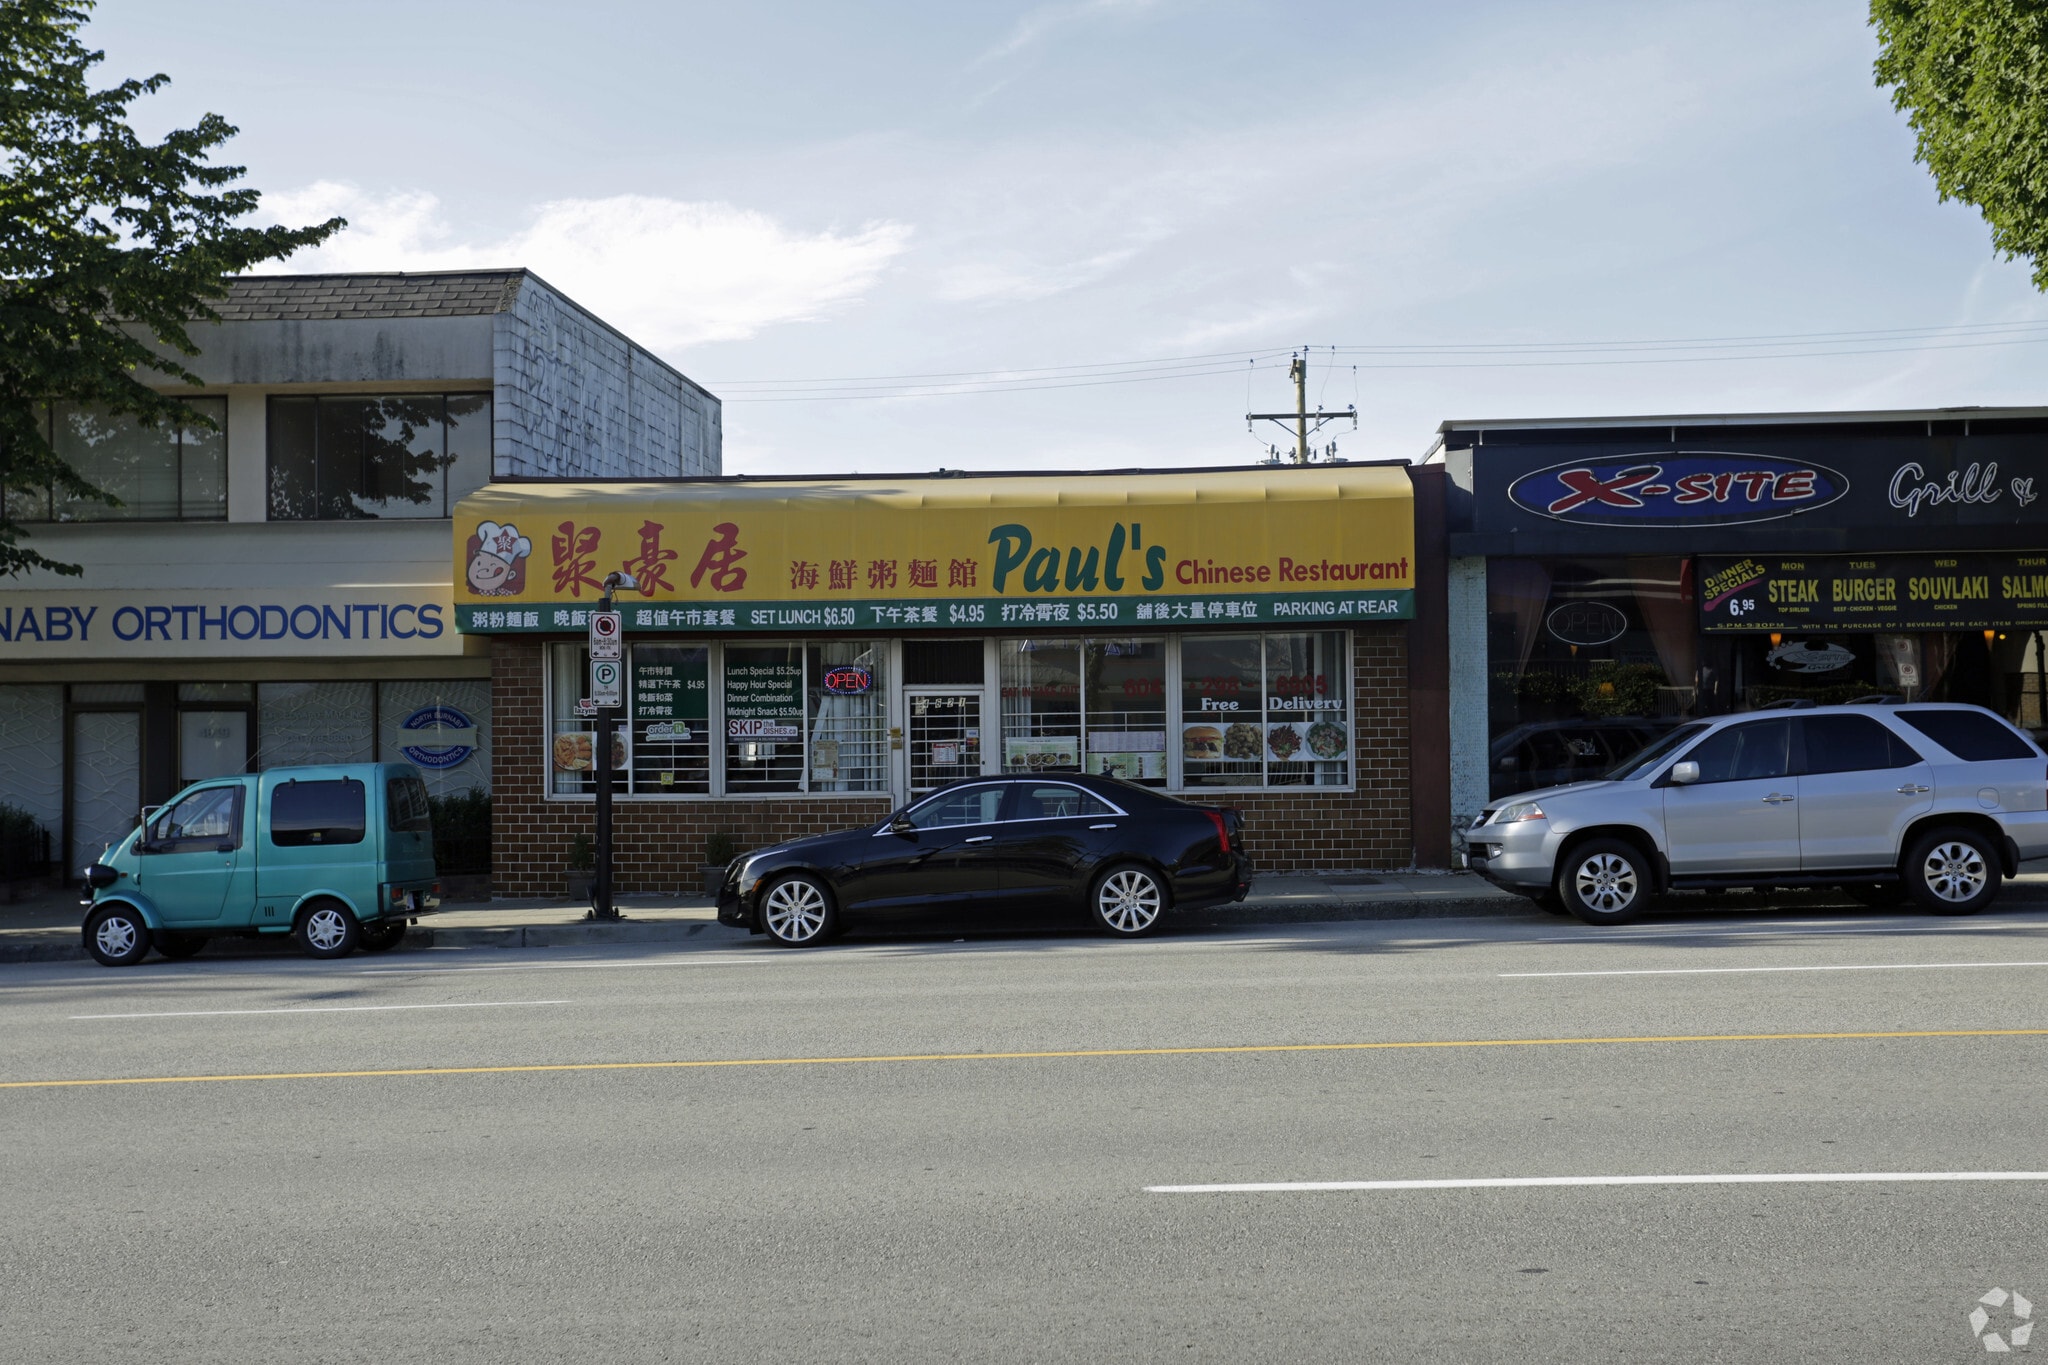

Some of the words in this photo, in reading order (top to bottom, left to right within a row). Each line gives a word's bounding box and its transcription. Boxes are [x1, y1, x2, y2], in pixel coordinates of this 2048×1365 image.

[1889, 462, 2002, 517] Grill
[988, 522, 1166, 594] Paul's
[1781, 562, 1805, 571] MON
[1849, 561, 1876, 570] TUES
[1935, 559, 1957, 568] WED
[1175, 559, 1271, 585] Chinese
[1279, 557, 1409, 582] Restaurant
[1704, 558, 1755, 589] DINNER
[1704, 564, 1766, 600] SPECIALS
[1832, 578, 1896, 602] BURGER
[1909, 576, 1989, 601] SOUVLAKI
[1768, 579, 1819, 603] STEAK
[870, 606, 938, 623] 下午茶餐
[949, 604, 985, 623] $4.95
[1077, 602, 1118, 621] $5.50
[1273, 601, 1335, 616] PARKING
[1338, 601, 1354, 614] AT
[1358, 600, 1398, 613] REAR
[1729, 599, 1755, 616] 6.95
[112, 603, 444, 641] ORTHODONTICS
[751, 609, 776, 625] SET
[778, 609, 822, 624] LUNCH
[824, 607, 855, 627] $6.50
[1552, 611, 1618, 635] OPEN
[601, 668, 612, 680] P
[727, 667, 748, 676] Lunch
[750, 667, 774, 678] Special
[776, 666, 802, 677] $5.25up
[826, 673, 867, 688] OPEN
[687, 680, 705, 690] $4.95
[727, 680, 748, 691] Happy
[750, 680, 766, 689] Hour
[767, 679, 793, 691] Special
[1002, 686, 1019, 698] EAT
[1022, 686, 1031, 697] IN
[1124, 677, 1163, 697] 604
[727, 693, 749, 703] Dinner
[750, 693, 793, 703] Combination
[1201, 698, 1239, 711] Free
[1268, 696, 1342, 711] Delivery
[410, 712, 432, 728] NORTH
[434, 711, 464, 728] BURNABY
[727, 707, 756, 718] Midnight
[757, 707, 778, 716] Snack
[729, 719, 762, 735] SKIP
[763, 720, 773, 728] the
[763, 727, 796, 735] DISHES.ca
[408, 746, 464, 764] ORTHODONTICS
